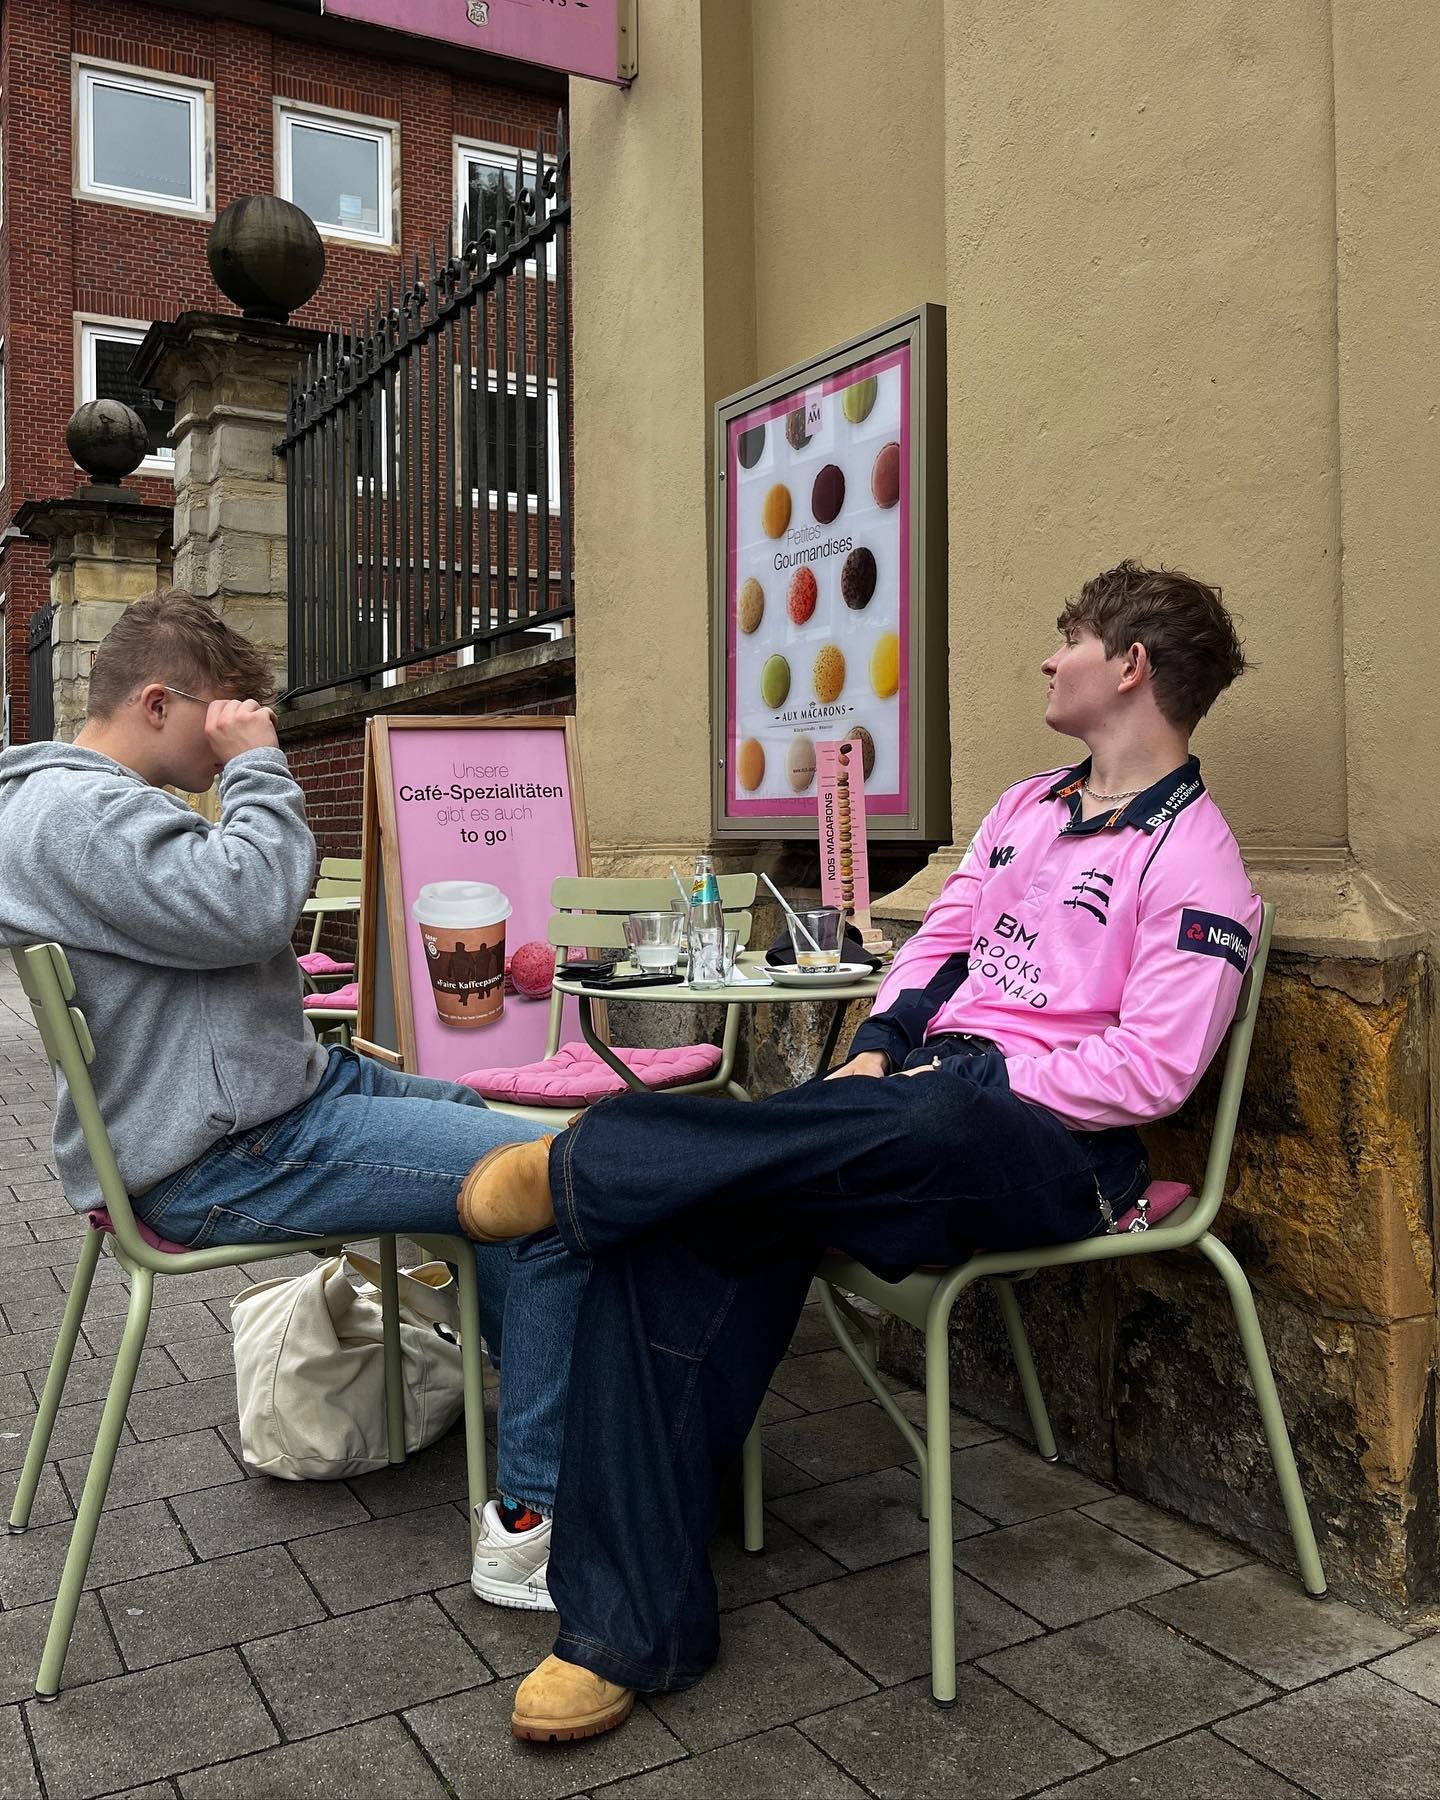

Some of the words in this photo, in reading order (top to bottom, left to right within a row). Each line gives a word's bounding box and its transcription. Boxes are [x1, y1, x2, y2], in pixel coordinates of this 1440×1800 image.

[787, 525, 821, 547] Petites
[774, 537, 852, 571] Gourmandises
[782, 711, 798, 722] AUX
[800, 704, 846, 720] MACARONS
[453, 763, 509, 779] Unsere
[399, 784, 563, 803] Café-Spezialitäten
[1165, 782, 1188, 806] BROOKS
[1171, 780, 1200, 810] MACDONALD
[436, 806, 465, 826] gibt
[470, 808, 489, 821] es
[494, 803, 532, 821] auch
[824, 792, 835, 855] MACARONS
[1145, 807, 1173, 828] BM
[460, 828, 478, 842] to
[827, 858, 836, 881] NOS
[994, 912, 1039, 951] BM
[1207, 926, 1248, 961] NatWest
[973, 935, 1041, 984] ROOKS
